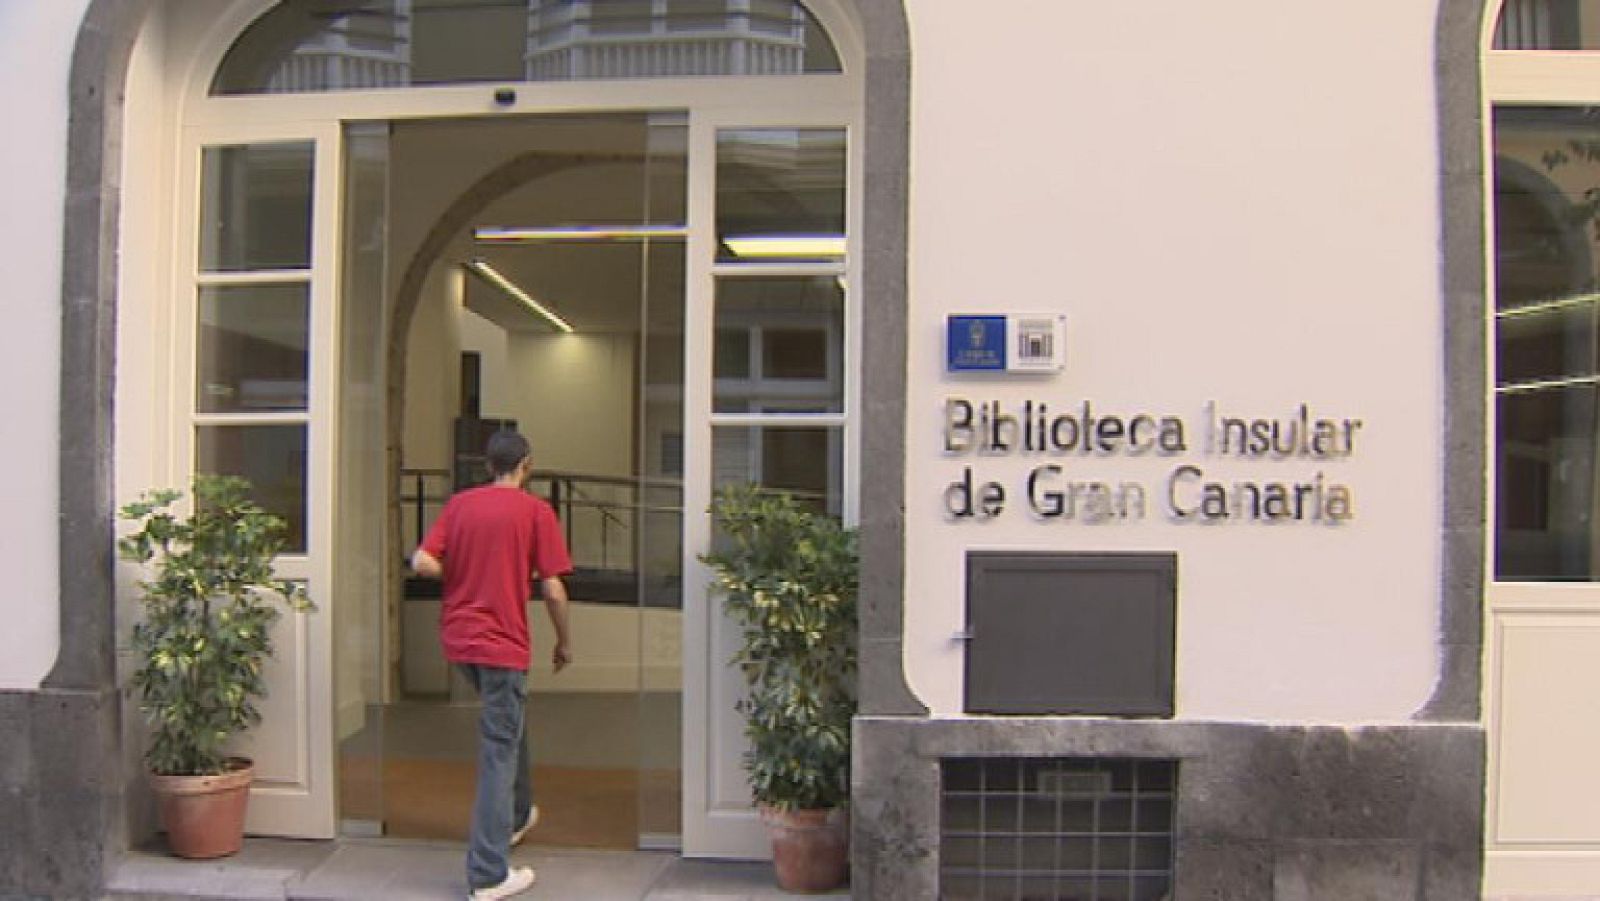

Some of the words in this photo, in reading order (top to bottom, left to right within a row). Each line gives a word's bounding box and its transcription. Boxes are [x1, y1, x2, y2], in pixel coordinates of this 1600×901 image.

[944, 398, 1186, 452] Biblioteca
[1206, 400, 1362, 455] Insular
[944, 467, 1005, 518] de
[1028, 465, 1146, 519] Gran
[1168, 465, 1352, 521] Canaria
